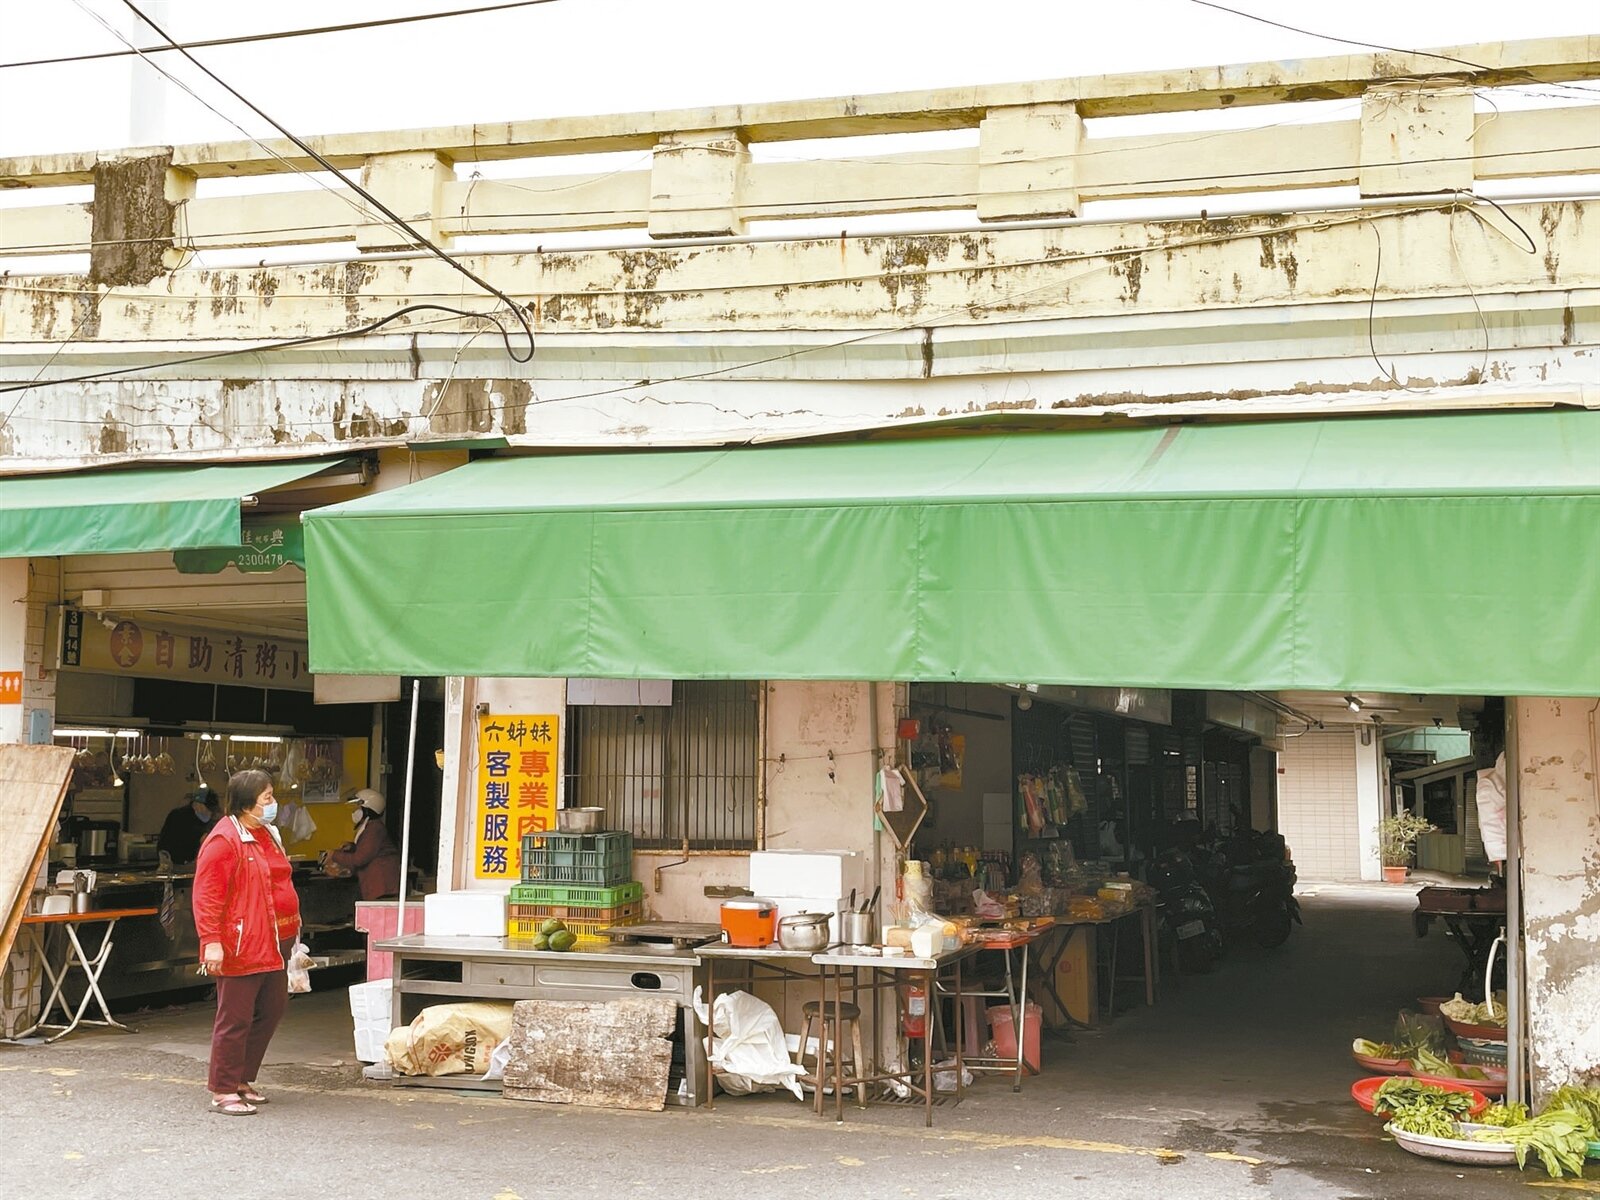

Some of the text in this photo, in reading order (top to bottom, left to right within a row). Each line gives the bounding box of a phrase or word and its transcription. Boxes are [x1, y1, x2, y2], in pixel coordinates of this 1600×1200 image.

[238, 554, 283, 566] 2300478
[484, 720, 552, 747] 六姊妹
[482, 750, 511, 874] 客製服務
[515, 750, 550, 870] 專業肉
